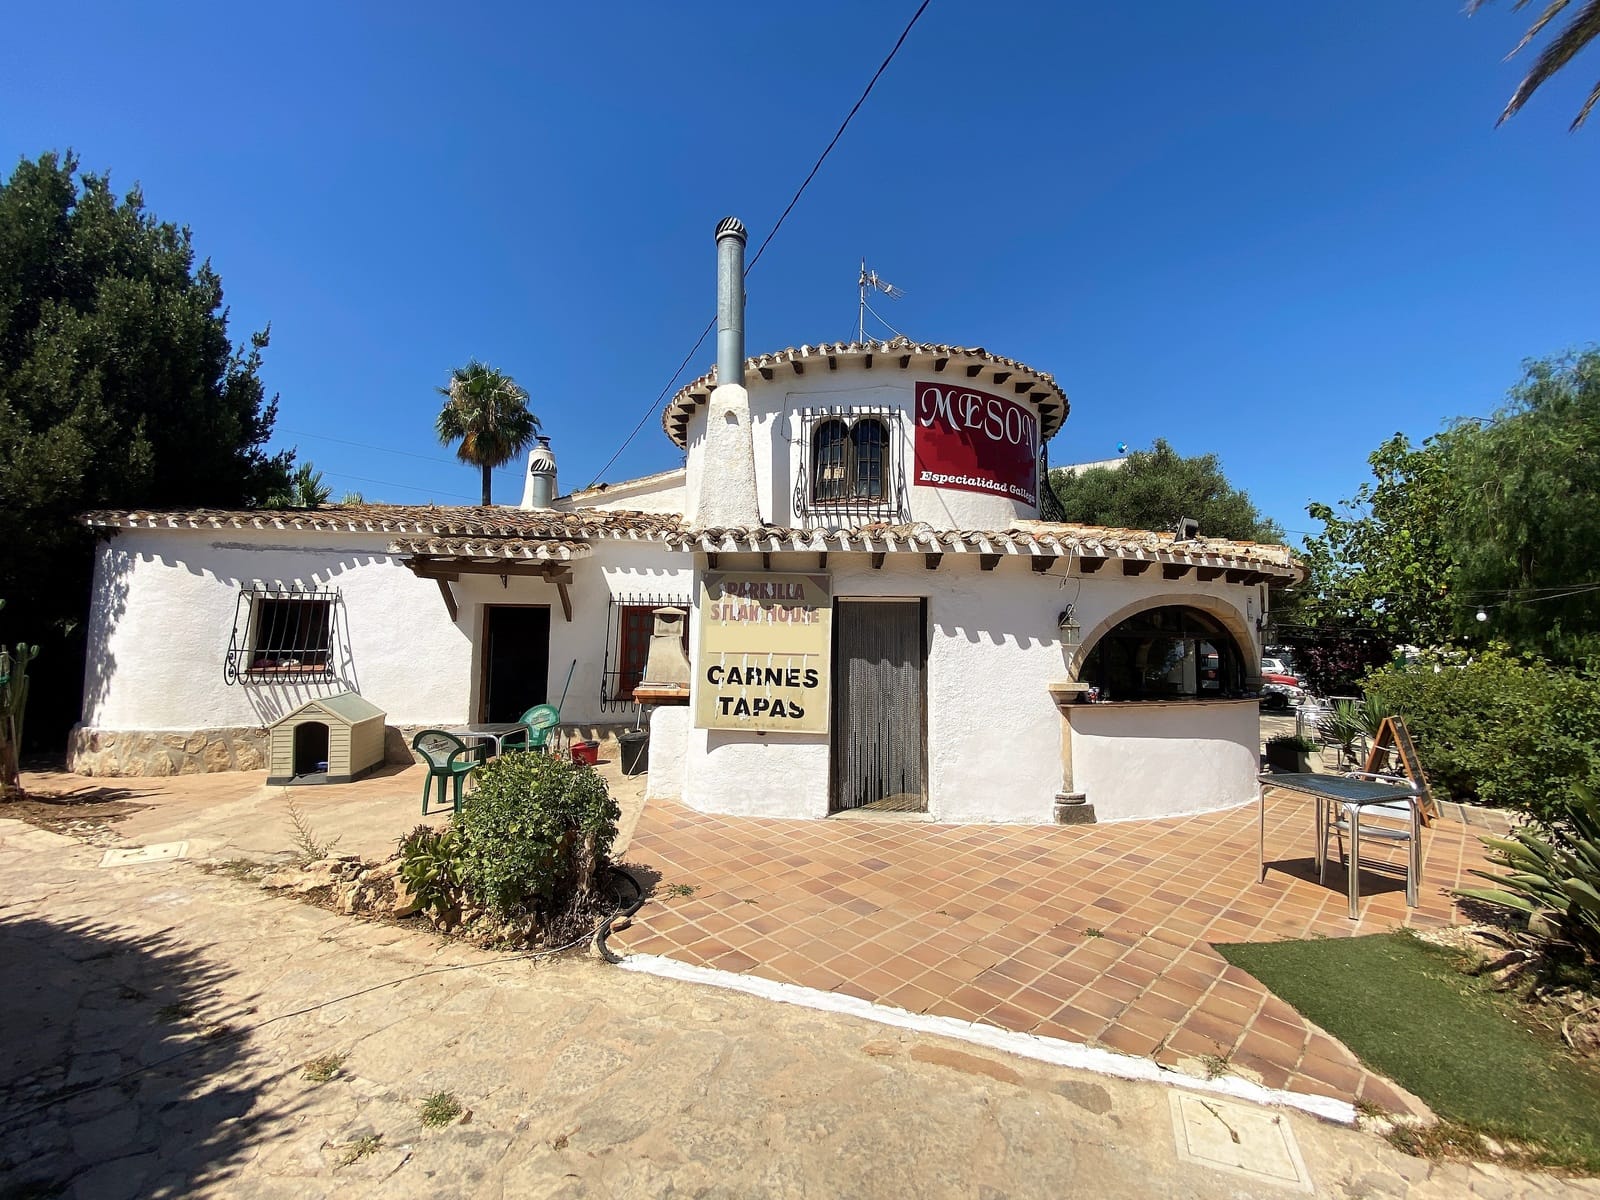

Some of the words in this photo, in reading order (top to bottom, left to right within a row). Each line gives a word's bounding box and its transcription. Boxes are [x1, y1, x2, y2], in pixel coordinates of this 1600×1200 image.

[920, 387, 1036, 460] MESON
[920, 471, 1008, 493] Especialidad
[707, 665, 819, 689] CARNES
[719, 696, 805, 719] TAPAS
